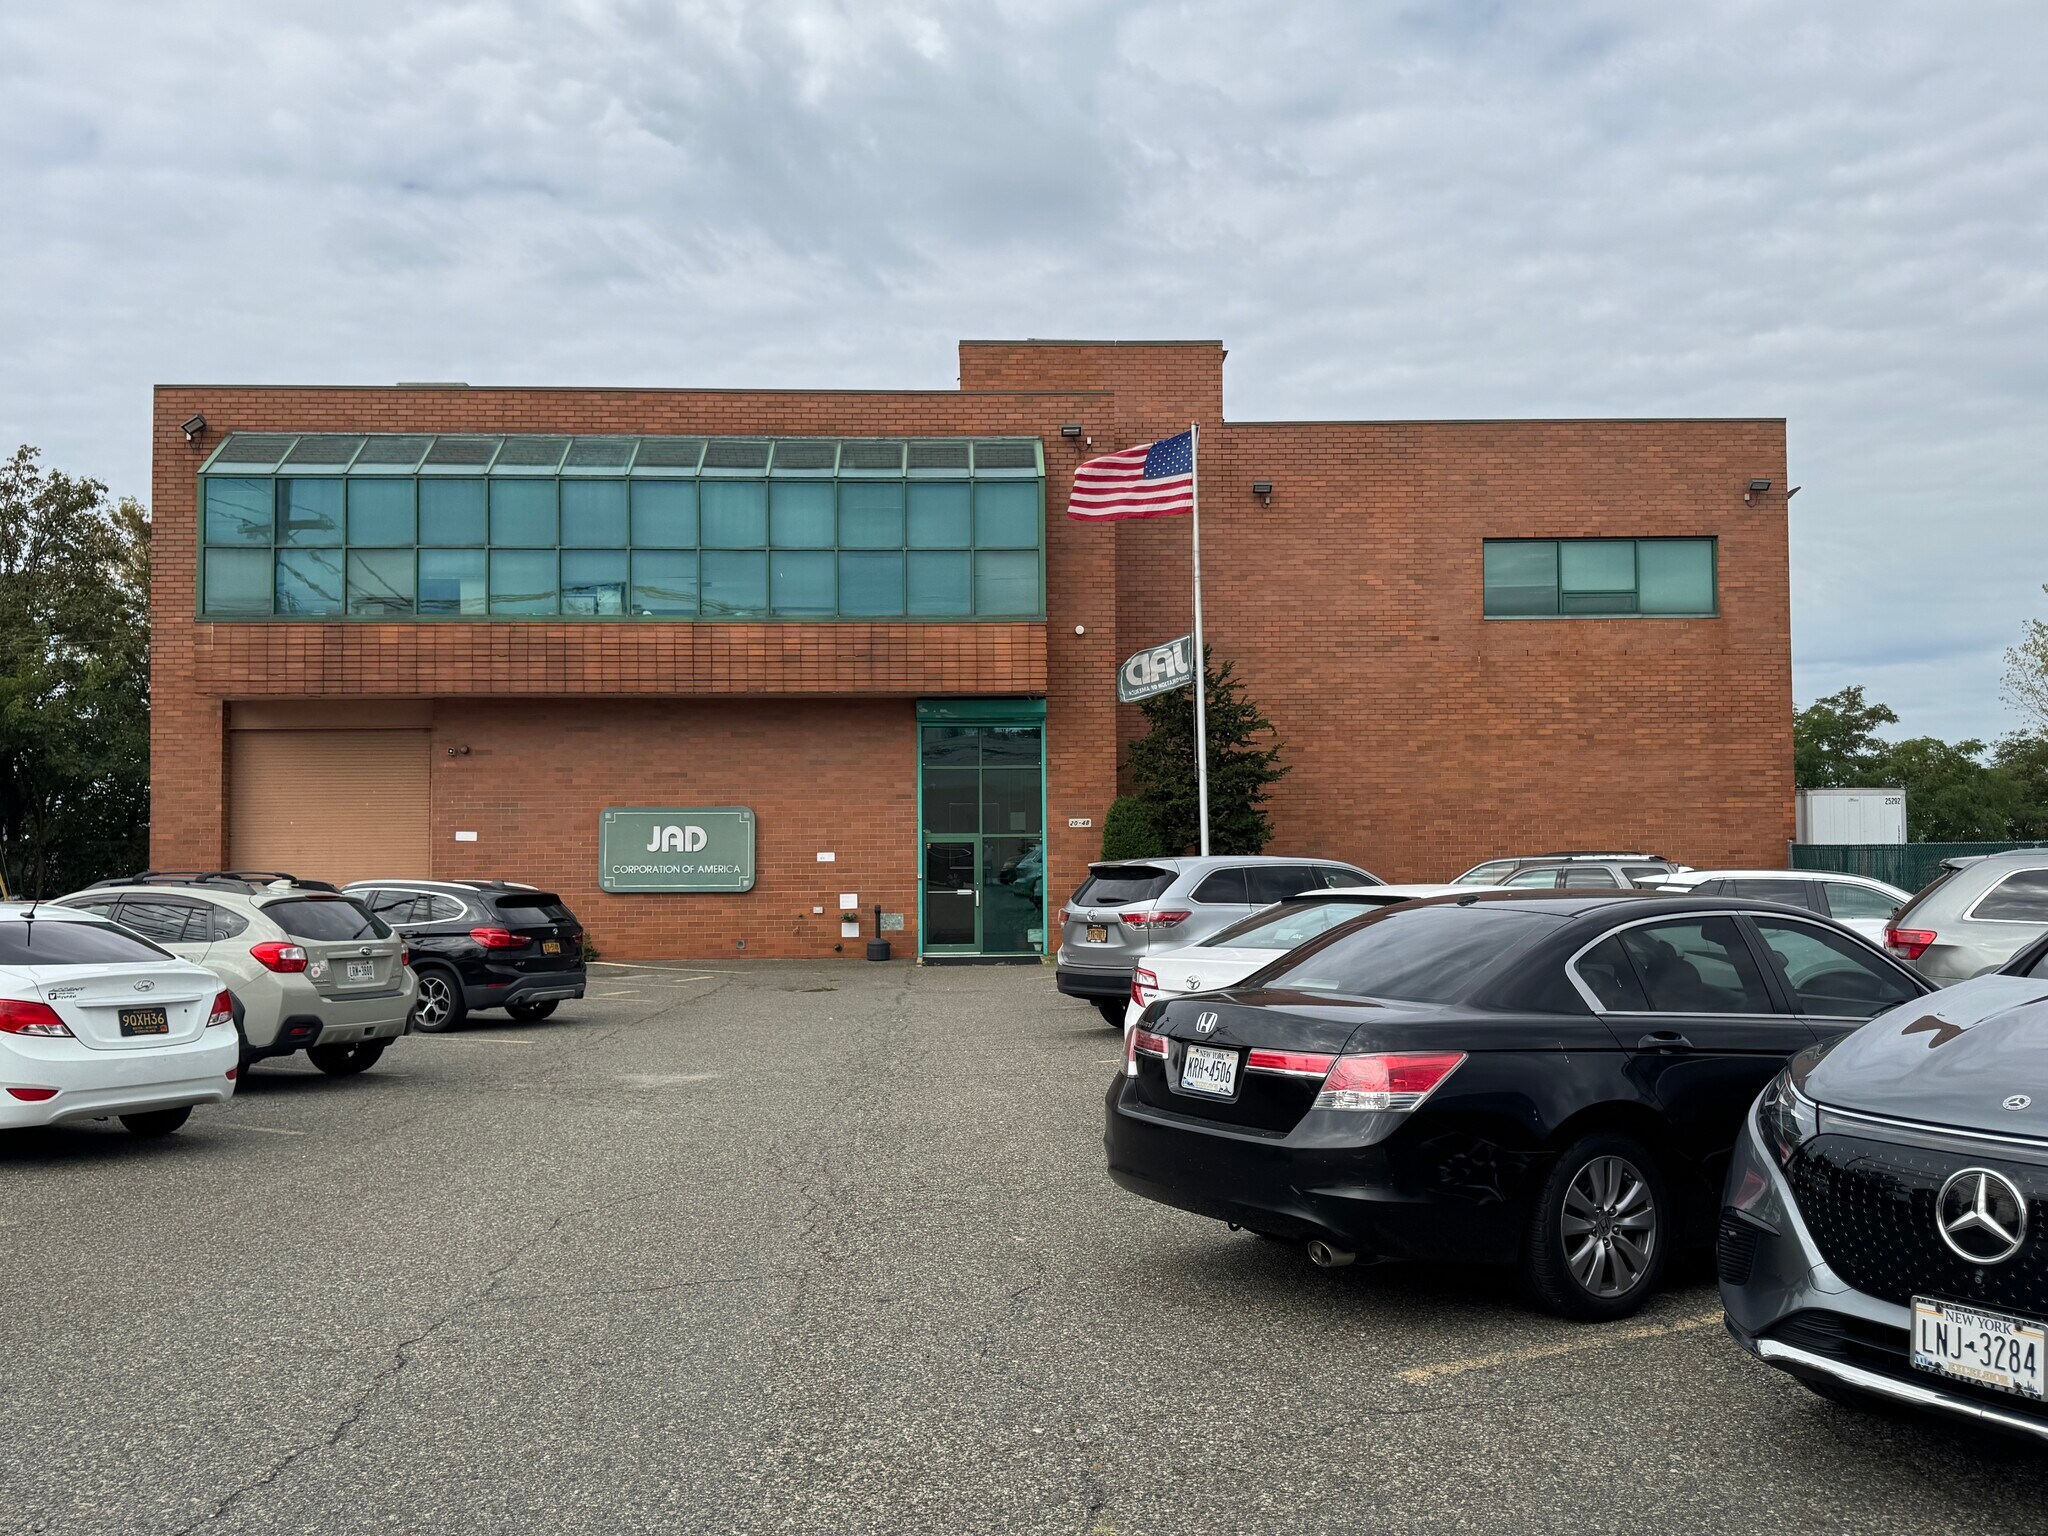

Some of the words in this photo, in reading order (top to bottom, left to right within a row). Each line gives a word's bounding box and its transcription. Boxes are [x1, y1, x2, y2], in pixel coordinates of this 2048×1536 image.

[646, 825, 708, 853] JAD
[612, 864, 680, 874] CORPORATION
[682, 864, 694, 874] OF
[698, 864, 740, 874] AMERICA
[122, 1012, 165, 1027] 9QXH36
[1945, 1309, 1974, 1327] NEW
[1977, 1316, 2013, 1336] YORK
[1915, 1362, 2042, 1401] MANHATTAN
